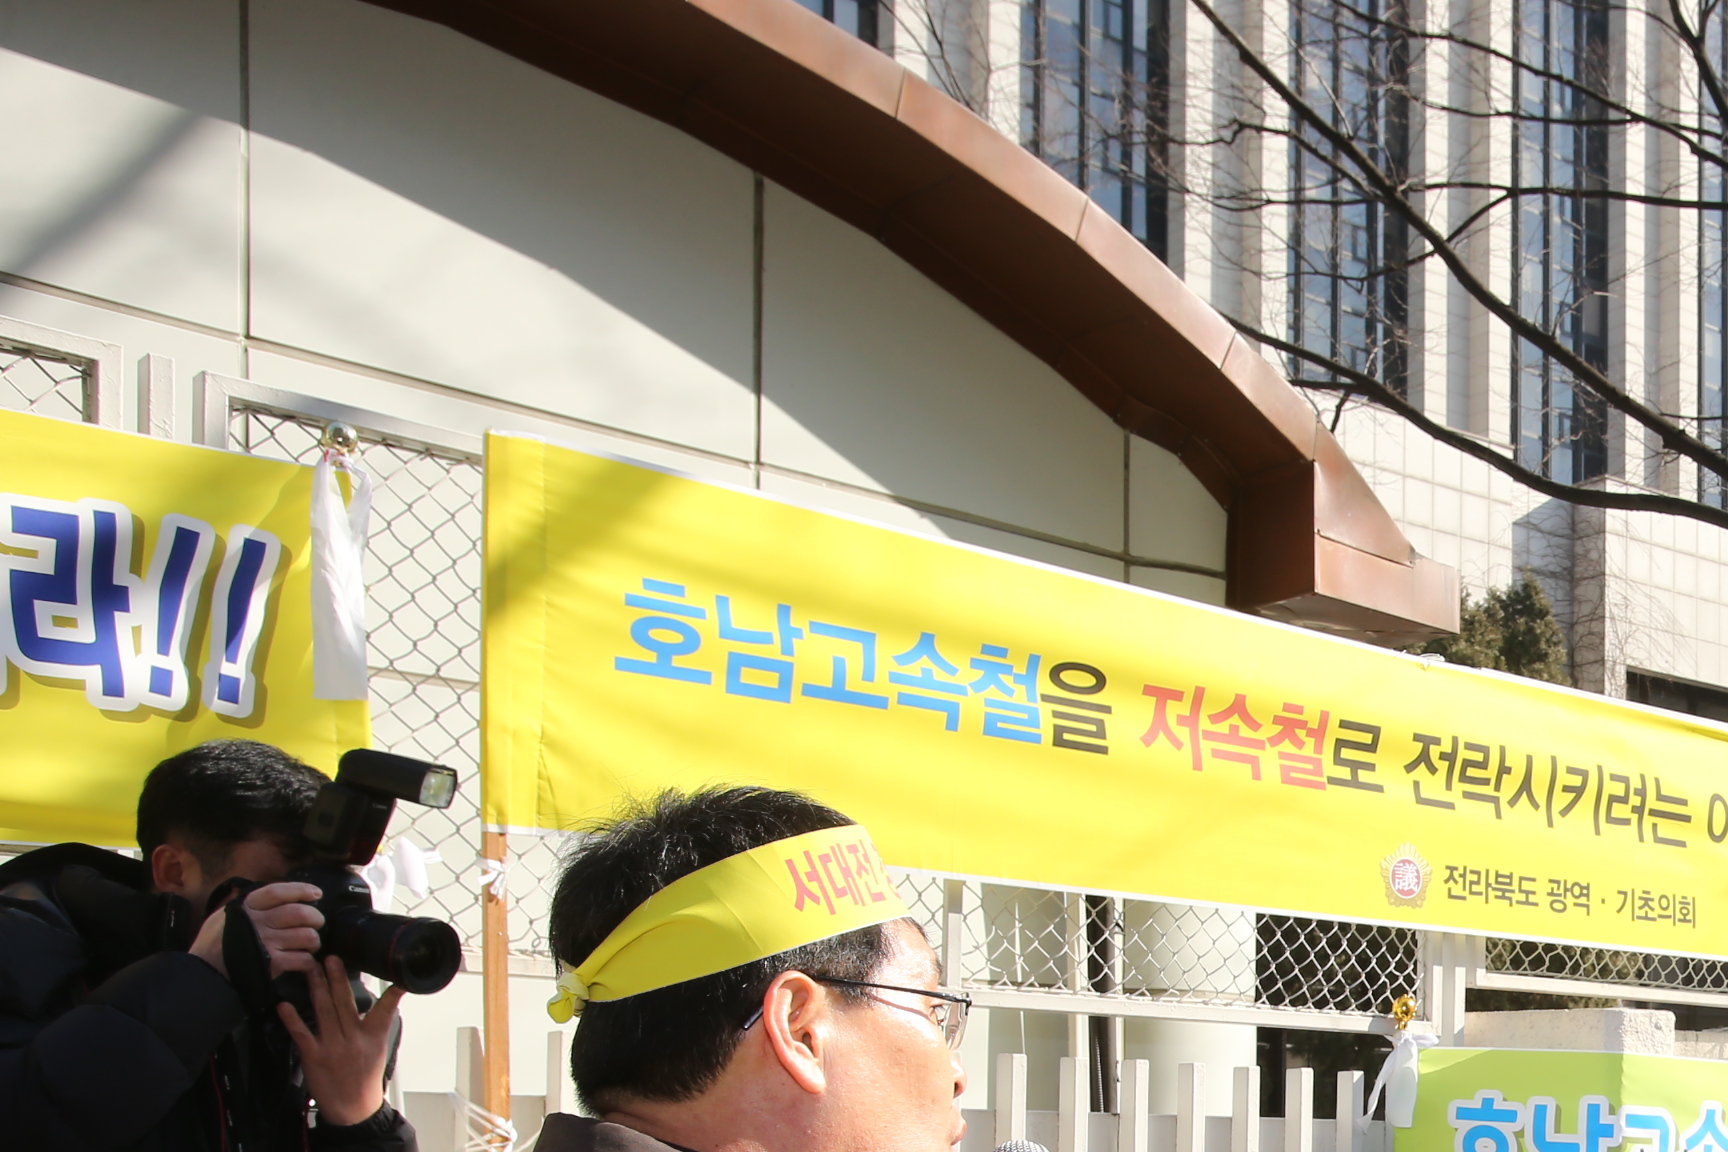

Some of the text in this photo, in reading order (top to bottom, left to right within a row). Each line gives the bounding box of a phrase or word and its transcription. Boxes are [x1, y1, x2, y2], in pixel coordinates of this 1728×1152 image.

[615, 576, 1113, 755] 호남고속철을
[1140, 683, 1385, 792] 저속철로
[1403, 731, 1693, 847] 전락시키려는
[784, 839, 887, 916] 서대전
[1443, 865, 1539, 907] 전라북도
[1546, 878, 1591, 916] 광역
[1616, 888, 1696, 928] 기초의회
